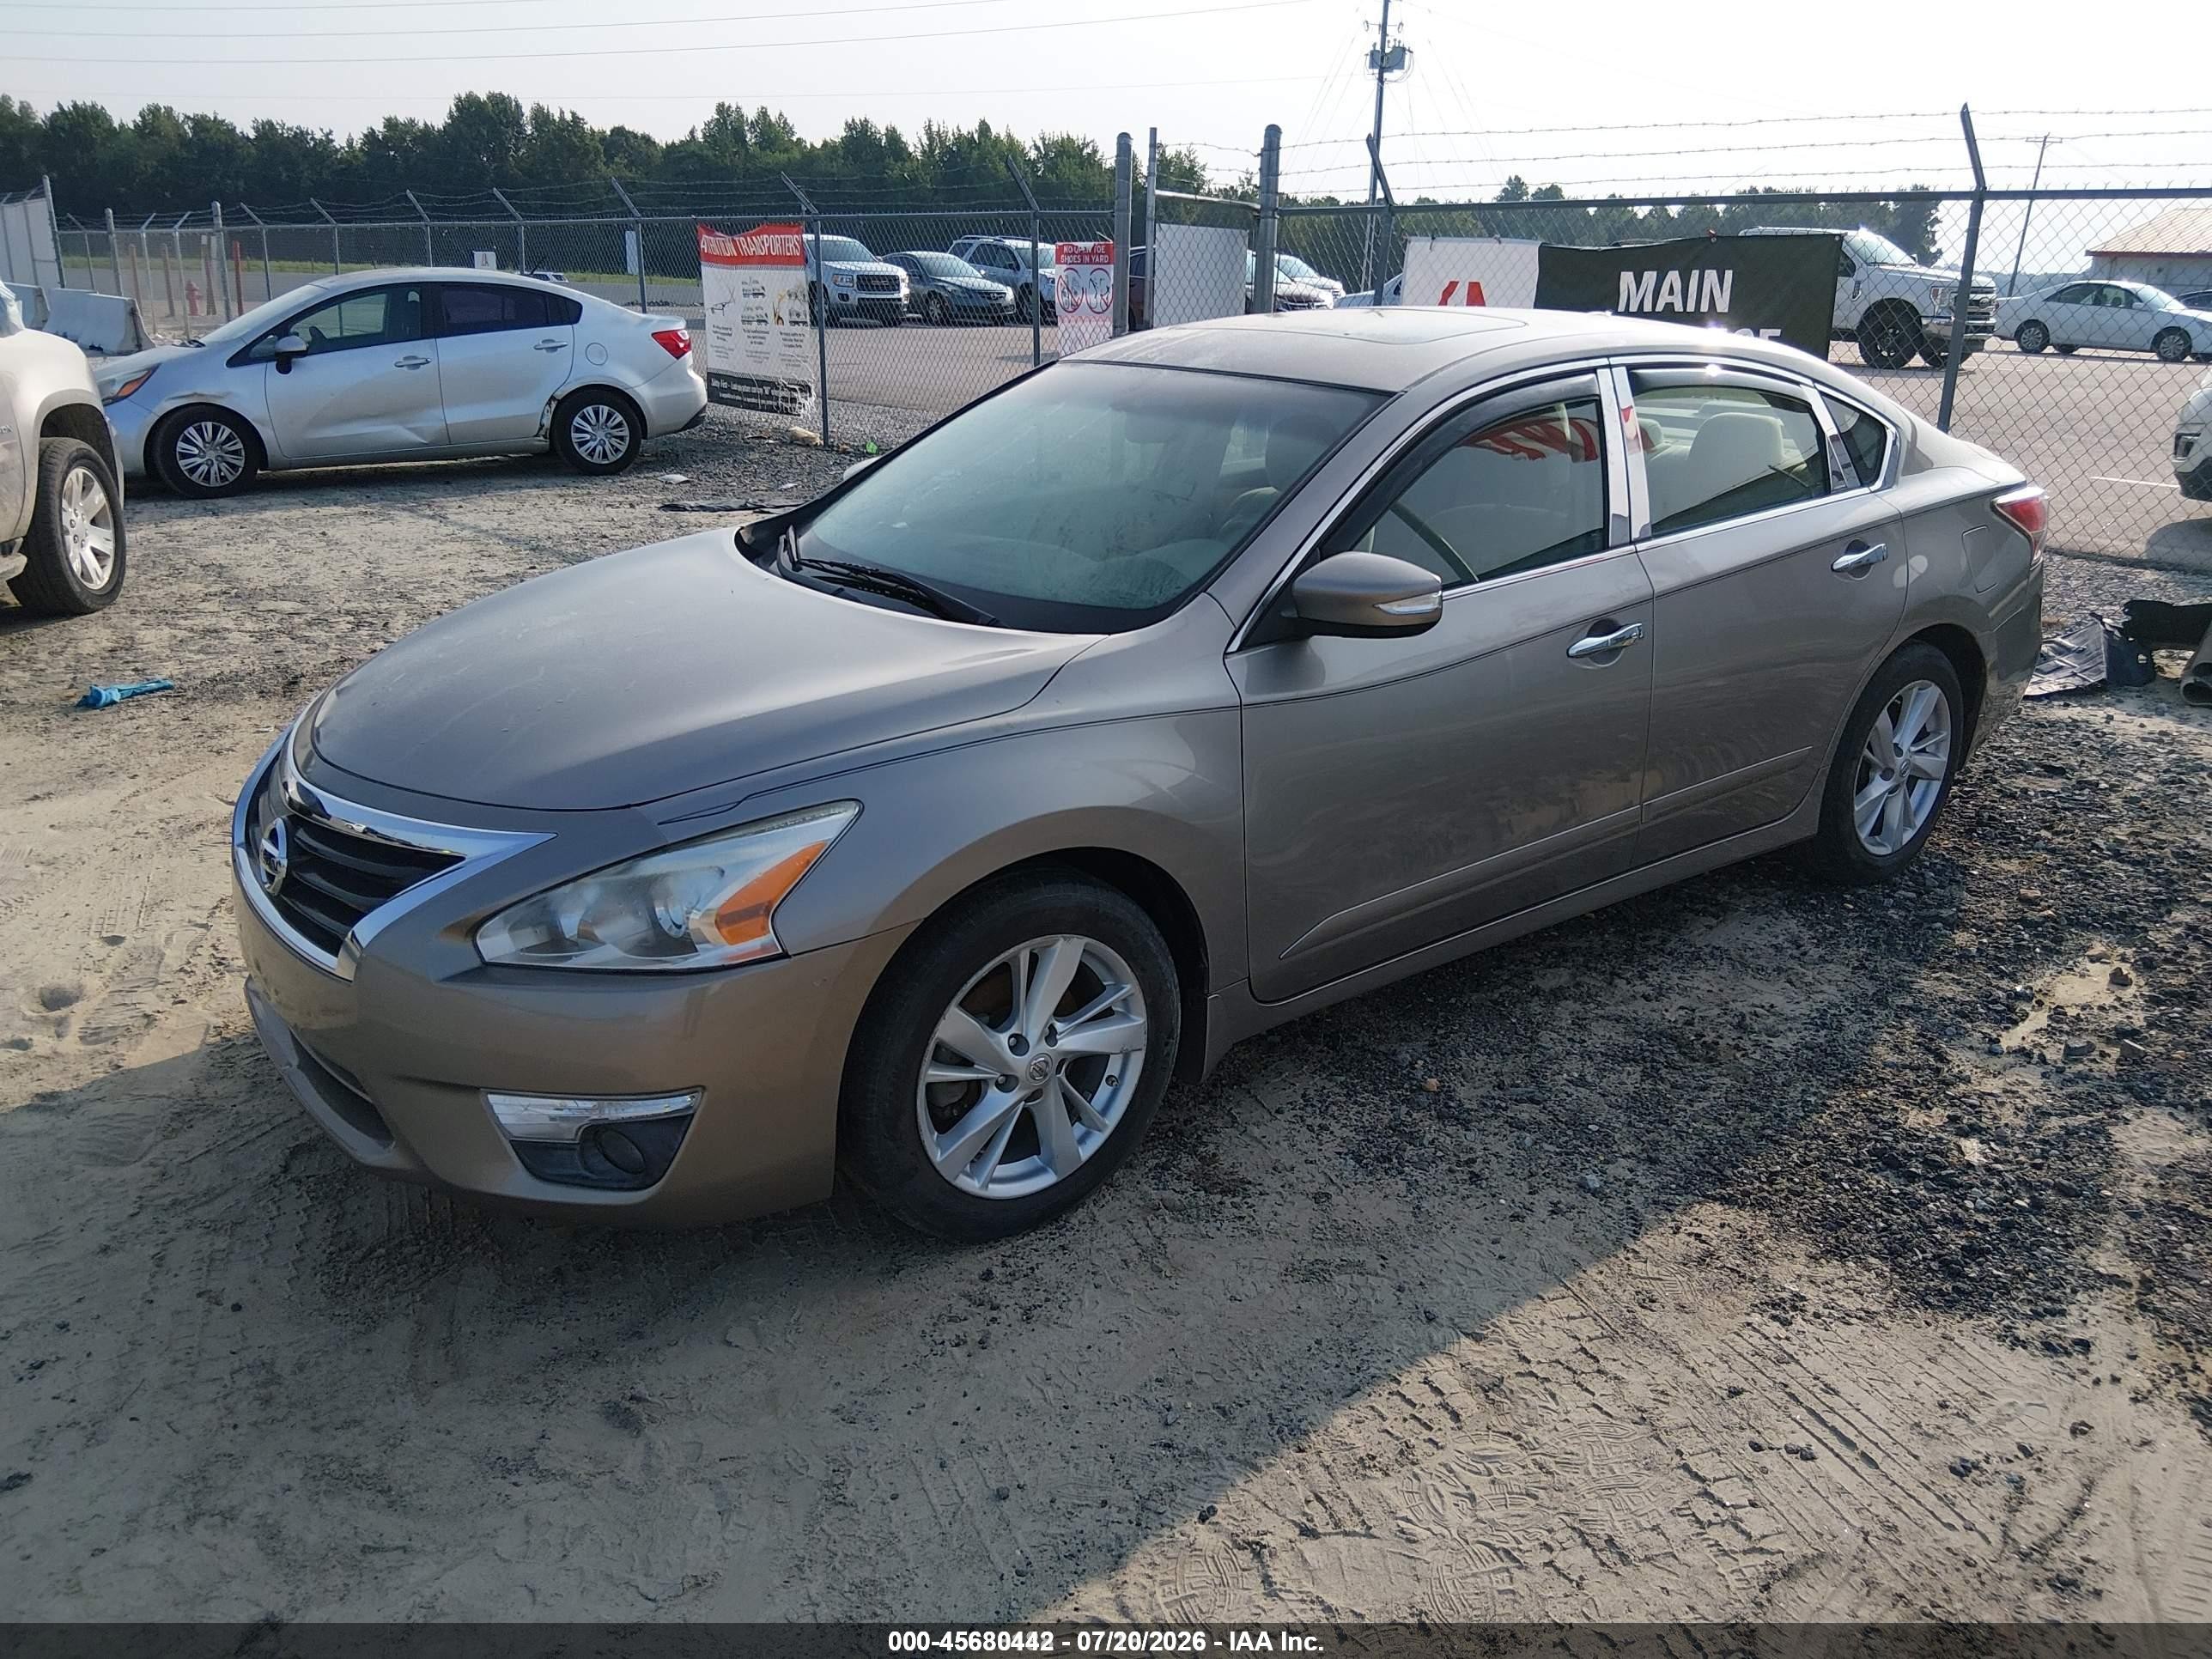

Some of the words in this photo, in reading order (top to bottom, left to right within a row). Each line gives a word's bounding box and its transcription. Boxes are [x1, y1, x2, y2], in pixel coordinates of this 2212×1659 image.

[700, 234, 738, 257] ATTION
[1063, 245, 1073, 254] NO
[1093, 245, 1106, 253] TOE
[1060, 254, 1081, 263] SHOES
[1083, 254, 1090, 264] IN
[1617, 270, 1733, 313] MAIN
